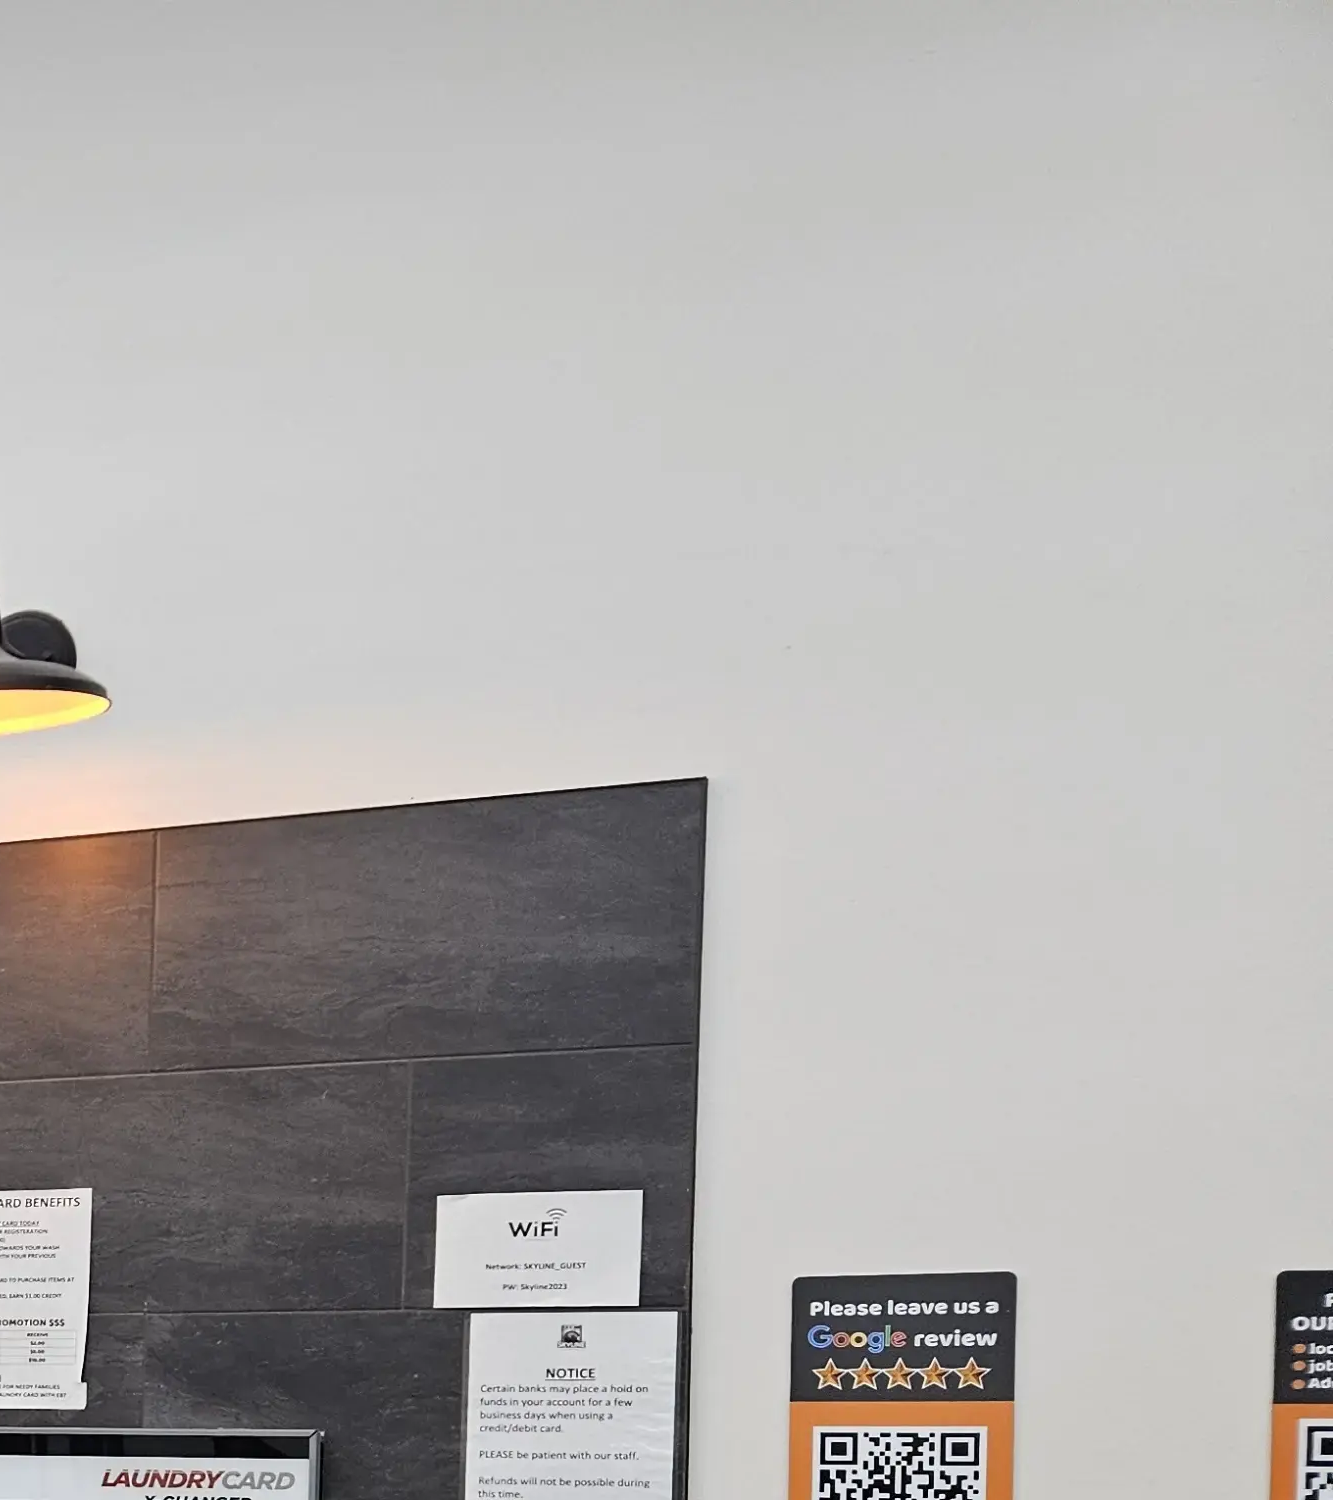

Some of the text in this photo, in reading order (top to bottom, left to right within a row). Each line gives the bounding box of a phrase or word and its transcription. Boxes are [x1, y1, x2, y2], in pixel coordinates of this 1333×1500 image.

[25, 1197, 80, 1208] BENEFITS
[508, 1221, 558, 1238] WiFi
[524, 1262, 586, 1270] SKYLINE_GUEST
[521, 1283, 568, 1291] Skyline2023
[810, 1300, 999, 1317] Please leave us a
[49, 1319, 65, 1327] $$$
[807, 1325, 998, 1354] Google review
[546, 1368, 596, 1379] NOTICE
[481, 1385, 515, 1393] Certain
[519, 1385, 546, 1393] banks
[550, 1386, 570, 1394] may
[573, 1385, 599, 1395] place
[610, 1385, 632, 1393] hold
[480, 1398, 507, 1406] funds
[521, 1400, 543, 1408] your
[588, 1398, 602, 1406] for
[614, 1398, 632, 1406] few
[524, 1412, 546, 1421] days
[578, 1412, 605, 1421] using
[480, 1424, 564, 1433] credit/debit card.
[479, 1451, 513, 1460] PLEASE
[517, 1451, 529, 1459] be
[532, 1452, 566, 1462] patient
[569, 1452, 591, 1460] with
[614, 1452, 639, 1460] staff.
[101, 1469, 295, 1490] LAUNDRYCARD
[479, 1477, 517, 1485] Refunds
[520, 1477, 537, 1485] will
[559, 1478, 571, 1486] be
[574, 1478, 615, 1488] possible
[618, 1479, 650, 1488] during
[478, 1490, 523, 1498] this time.
